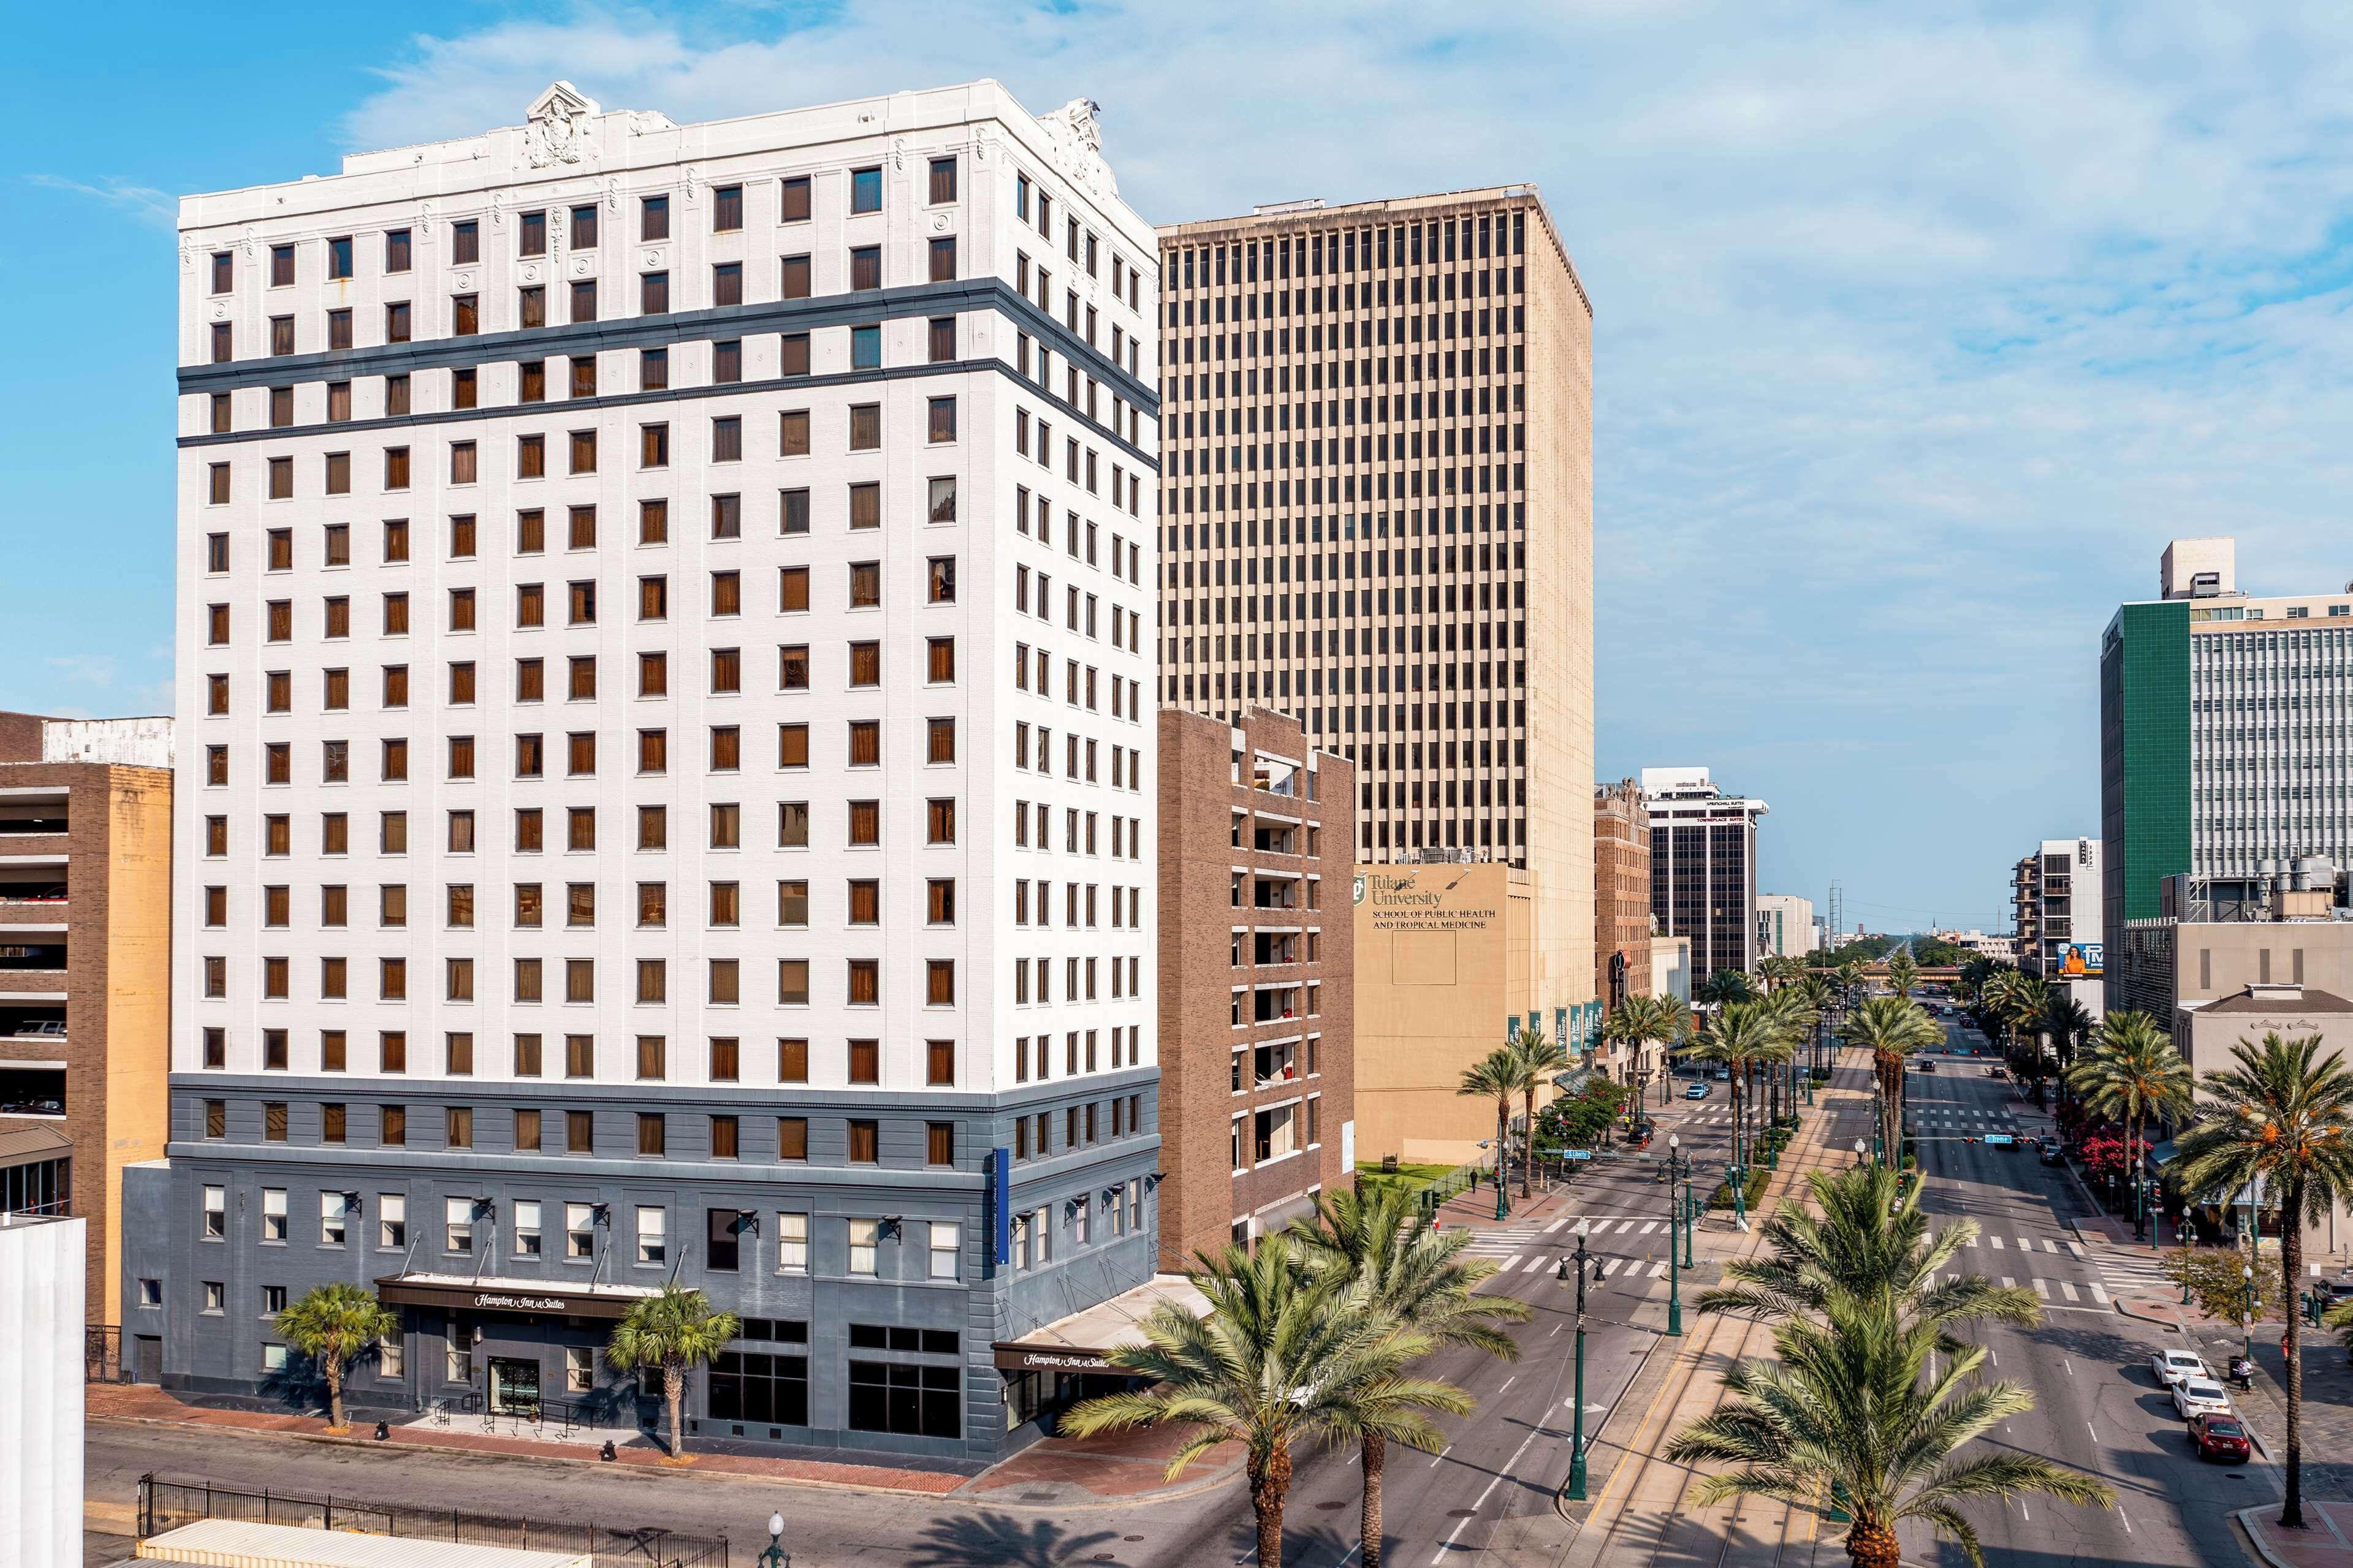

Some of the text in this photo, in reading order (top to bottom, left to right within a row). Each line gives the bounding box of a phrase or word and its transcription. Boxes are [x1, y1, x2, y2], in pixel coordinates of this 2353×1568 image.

[1368, 875, 1416, 890] Tulane
[1372, 890, 1442, 909] University
[475, 1293, 517, 1307] Hampton
[517, 1297, 538, 1308] Inn
[542, 1298, 564, 1309] Suites
[1024, 1354, 1063, 1366] Hampton
[1063, 1357, 1084, 1367] Inn
